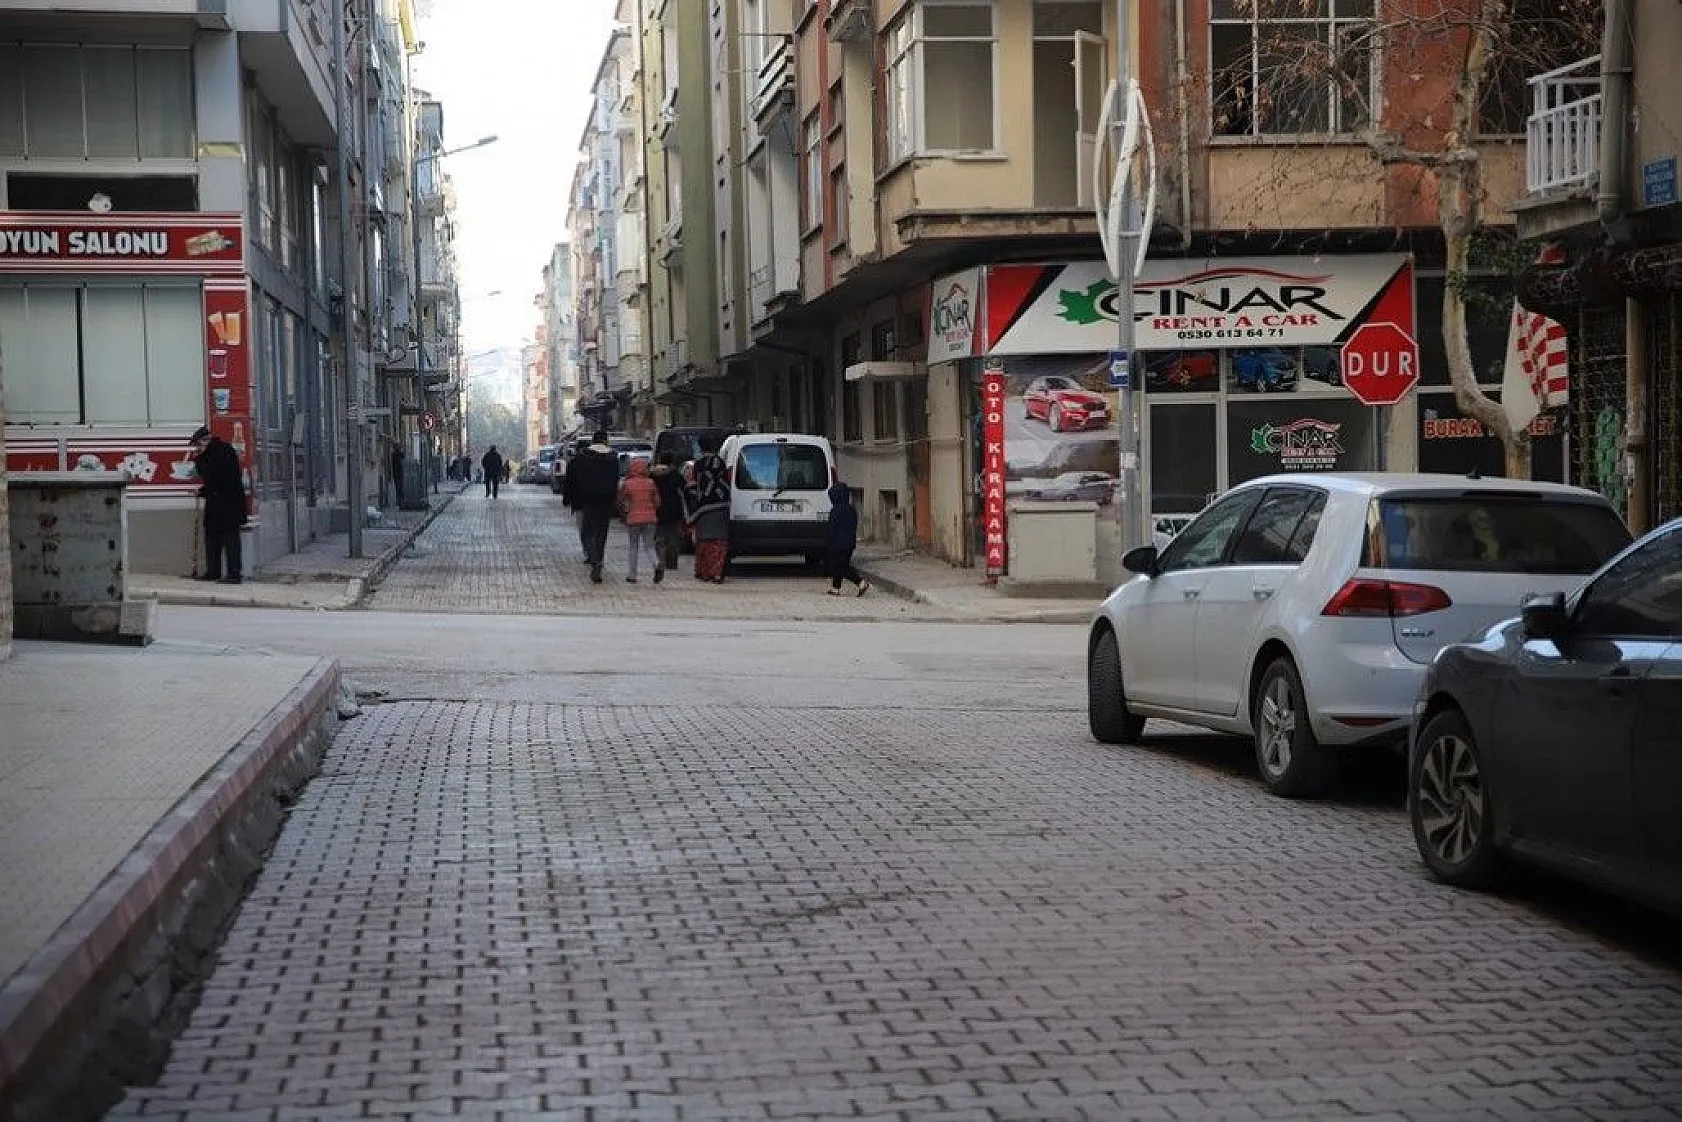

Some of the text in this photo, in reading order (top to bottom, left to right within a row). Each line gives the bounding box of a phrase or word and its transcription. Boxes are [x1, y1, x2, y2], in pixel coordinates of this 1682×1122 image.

[68, 231, 168, 255] SALONU
[1152, 313, 1319, 330] RENT A CAR
[1177, 330, 1212, 340] 0530
[1347, 351, 1413, 377] DUR
[988, 382, 1001, 424] OTO
